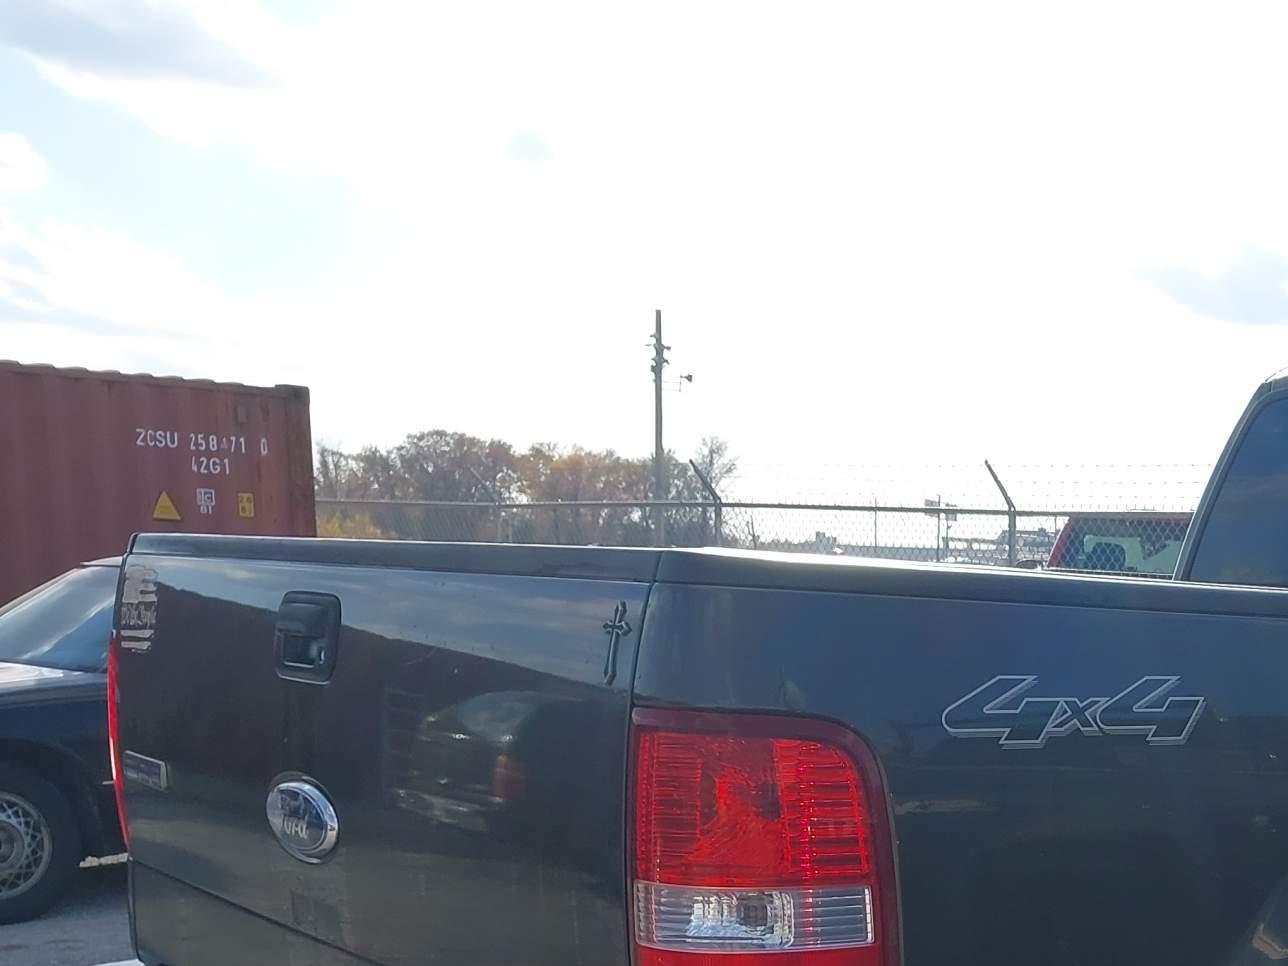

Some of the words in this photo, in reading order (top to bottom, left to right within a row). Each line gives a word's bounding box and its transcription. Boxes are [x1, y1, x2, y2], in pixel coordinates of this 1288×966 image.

[136, 428, 178, 448] ZCSU
[191, 456, 230, 475] 42G1
[942, 675, 1206, 750] 4x4
